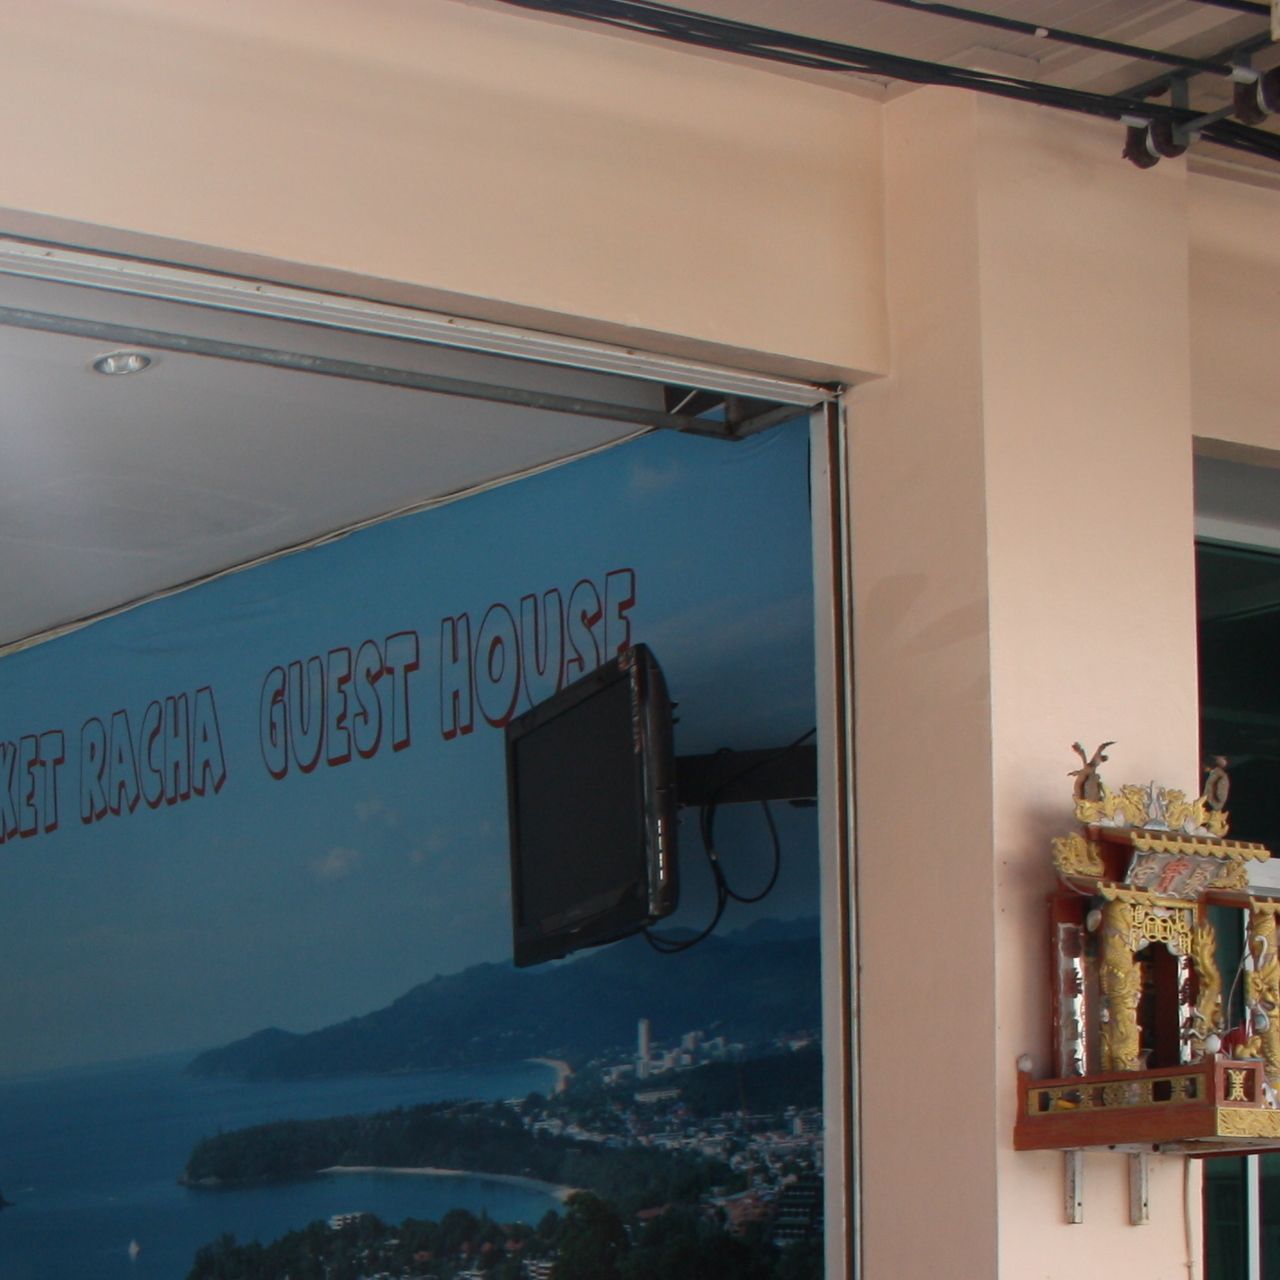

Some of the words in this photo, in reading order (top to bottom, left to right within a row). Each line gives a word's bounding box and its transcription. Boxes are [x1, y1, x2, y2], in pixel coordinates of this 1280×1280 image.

[80, 685, 228, 826] RACHA
[259, 630, 421, 781] GUEST
[440, 567, 638, 741] HOUSE
